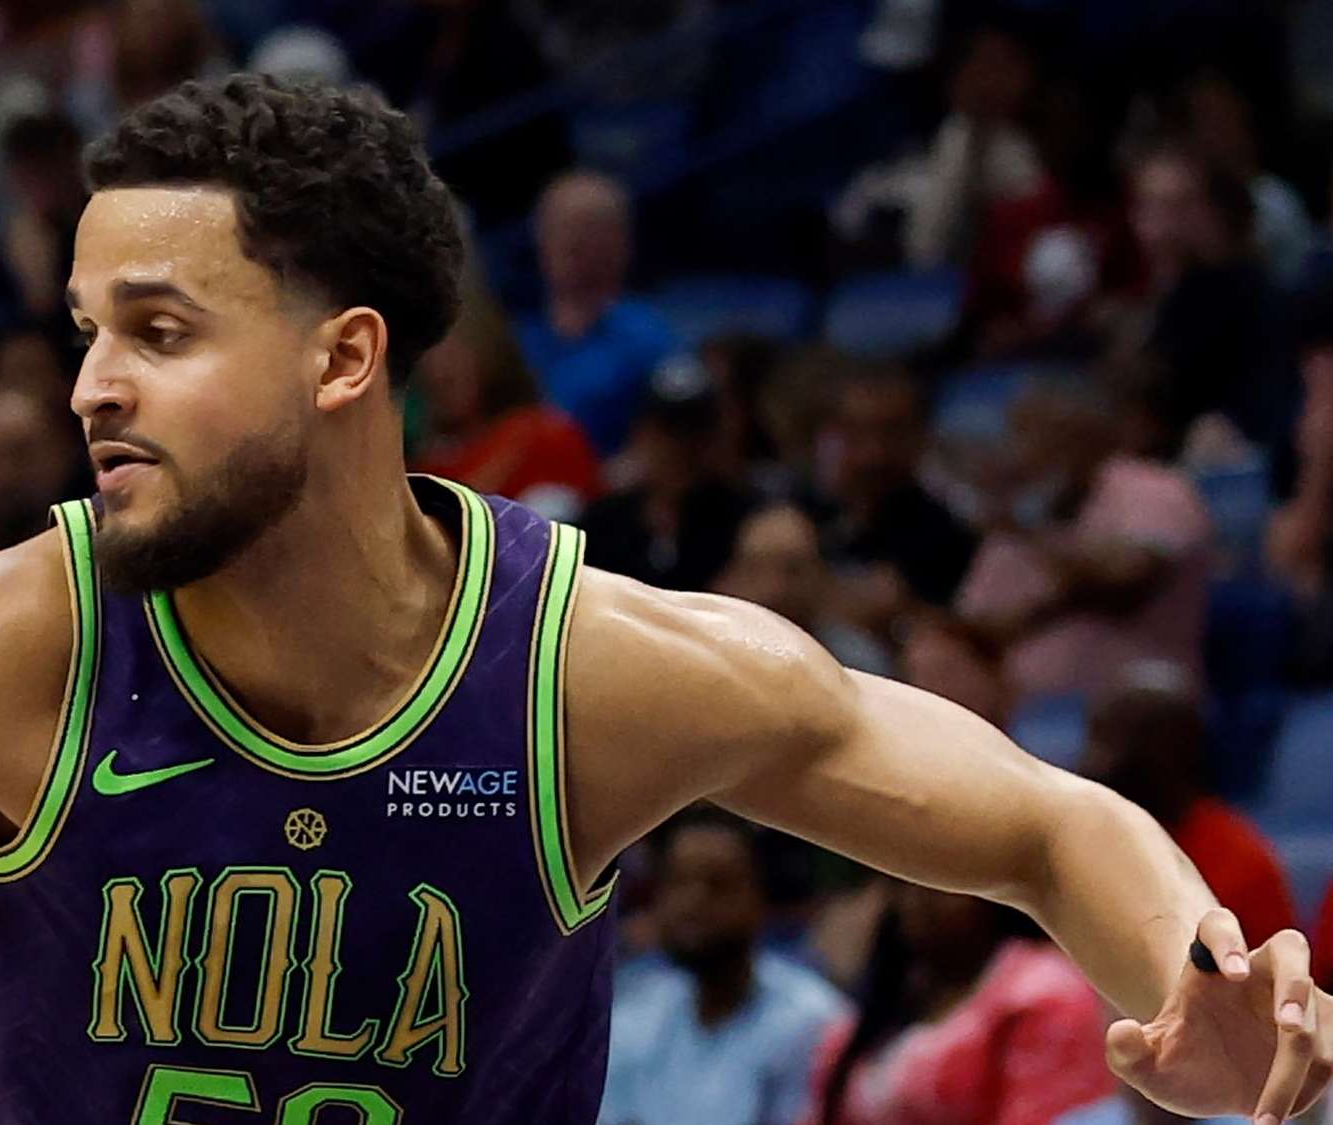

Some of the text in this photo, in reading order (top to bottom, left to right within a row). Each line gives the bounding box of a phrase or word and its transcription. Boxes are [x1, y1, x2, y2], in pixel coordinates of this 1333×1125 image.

[388, 770, 518, 795] NEWAGE
[387, 802, 516, 817] PRODUCTS
[87, 866, 470, 1077] NOLA
